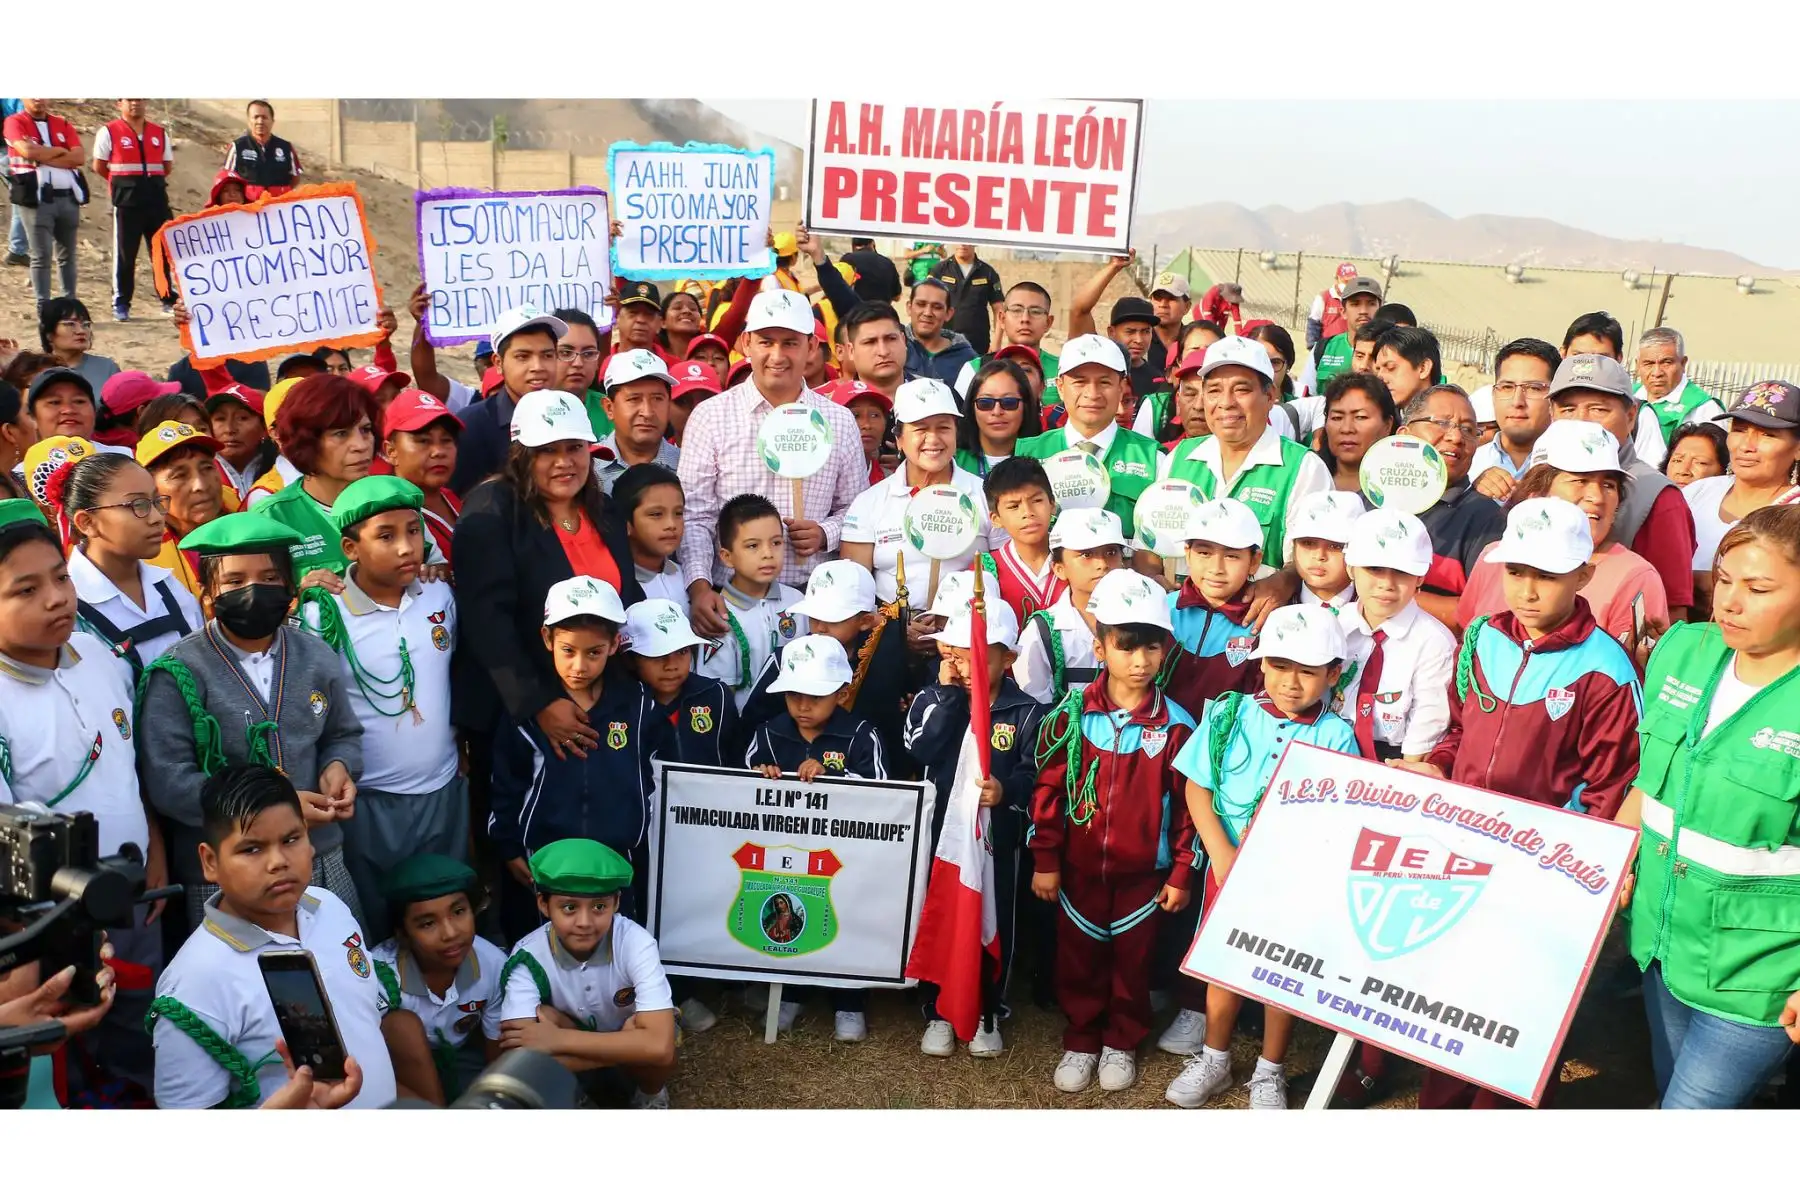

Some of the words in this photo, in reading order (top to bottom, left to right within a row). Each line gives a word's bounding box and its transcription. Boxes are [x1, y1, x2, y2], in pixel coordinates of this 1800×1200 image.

[824, 101, 891, 156] A.H.
[901, 101, 1024, 164] MARÍA
[1034, 106, 1127, 171] LEÓN
[625, 160, 687, 188] AA.HH.
[704, 162, 758, 189] JUAN
[626, 193, 759, 220] SOTOMAYOR
[821, 166, 1118, 237] PRESENTE
[245, 201, 350, 249] JUAN
[640, 224, 750, 263] PRESENTE
[184, 239, 368, 295] SOTOMAYOR
[445, 251, 494, 284] LES
[506, 249, 548, 279] DA
[561, 246, 592, 277] LA
[191, 284, 371, 346] PRESENTE
[774, 434, 818, 443] CRUZADA
[774, 443, 808, 452] VERDE
[1380, 467, 1429, 478] CRUZADA
[1380, 477, 1418, 487] VERDE
[1053, 480, 1095, 490] CRUZADA
[1054, 488, 1087, 499] VERDE
[921, 513, 963, 525] CRUZADA
[934, 508, 952, 516] GRAN
[1151, 511, 1189, 520] CRUZAD
[920, 522, 953, 533] VERDE
[1151, 520, 1187, 530] VERDE
[755, 788, 781, 807] I.E.I
[804, 792, 829, 810] 141
[762, 815, 809, 835] VIRGEN
[811, 818, 828, 836] DE
[1278, 778, 1339, 804] I.E.P.
[1344, 778, 1420, 813] Divino
[1420, 792, 1513, 841] Corazón
[1511, 827, 1546, 856] de
[1538, 841, 1610, 895] Jesús
[781, 856, 792, 869] E
[1361, 839, 1385, 866] I
[1400, 848, 1429, 869] E
[1451, 858, 1477, 872] P
[1408, 872, 1451, 881] VENTANILLA
[763, 945, 798, 953] LEALTAD
[1226, 927, 1325, 979] INICIAL
[1360, 976, 1520, 1048] PRIMARIA
[1251, 966, 1306, 997] UGEL
[1316, 989, 1465, 1056] VENTANILLA
